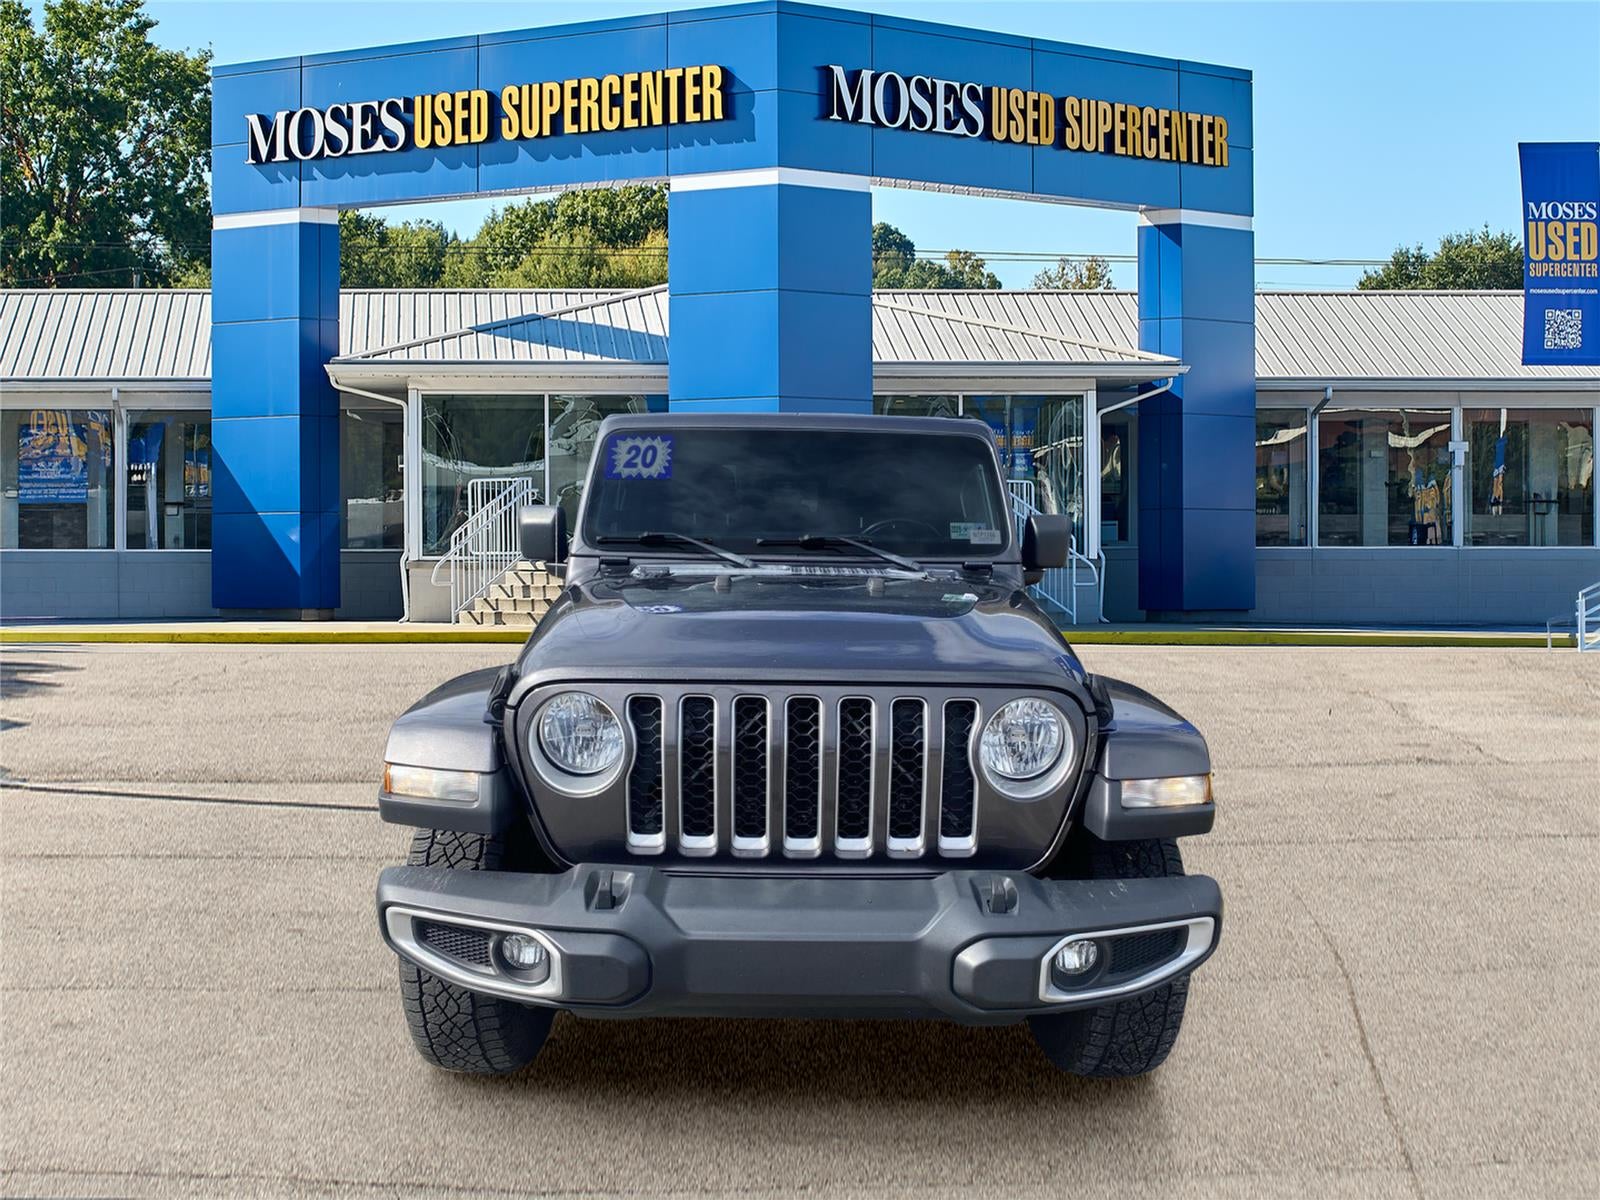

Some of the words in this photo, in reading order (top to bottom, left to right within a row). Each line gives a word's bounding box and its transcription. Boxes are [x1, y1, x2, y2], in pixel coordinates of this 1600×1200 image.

[244, 97, 406, 164] MOSES
[413, 89, 489, 149] USED
[501, 64, 725, 141] SUPERCENTER
[828, 64, 985, 138] MOSES
[991, 86, 1055, 146] USED
[1065, 96, 1230, 167] SUPERCENTER
[1528, 201, 1597, 219] MOSES
[1528, 221, 1598, 260] USED
[1529, 262, 1598, 277] SUPERCENTER
[622, 444, 658, 468] 20
